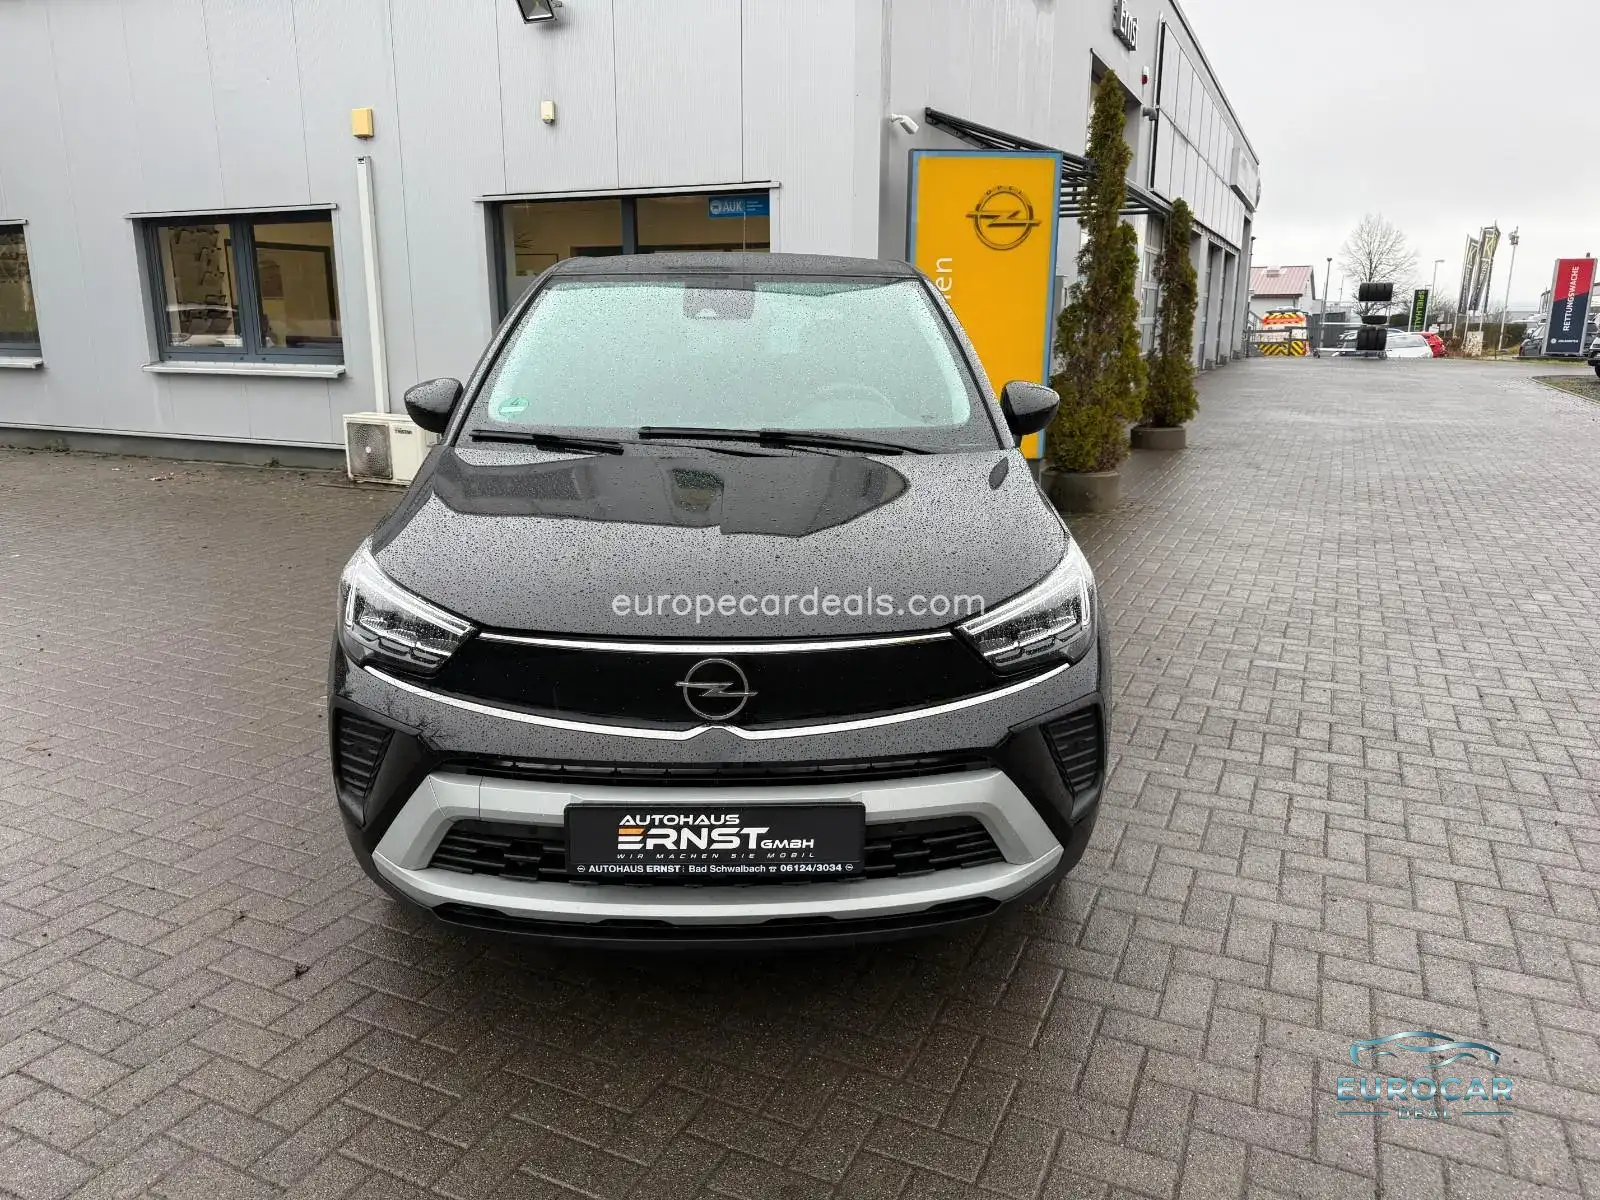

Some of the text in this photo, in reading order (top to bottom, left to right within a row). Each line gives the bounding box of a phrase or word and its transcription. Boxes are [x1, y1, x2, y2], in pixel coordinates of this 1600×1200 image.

[935, 256, 953, 300] en
[1413, 290, 1425, 332] SPIELHALL
[1562, 265, 1580, 332] RETTUNGSWACHE
[618, 814, 740, 826] AUTOHAUS
[617, 827, 769, 850] ERNST
[588, 863, 843, 873] AUTOHAUS ERNST Bad Schwalbach 06124/3034
